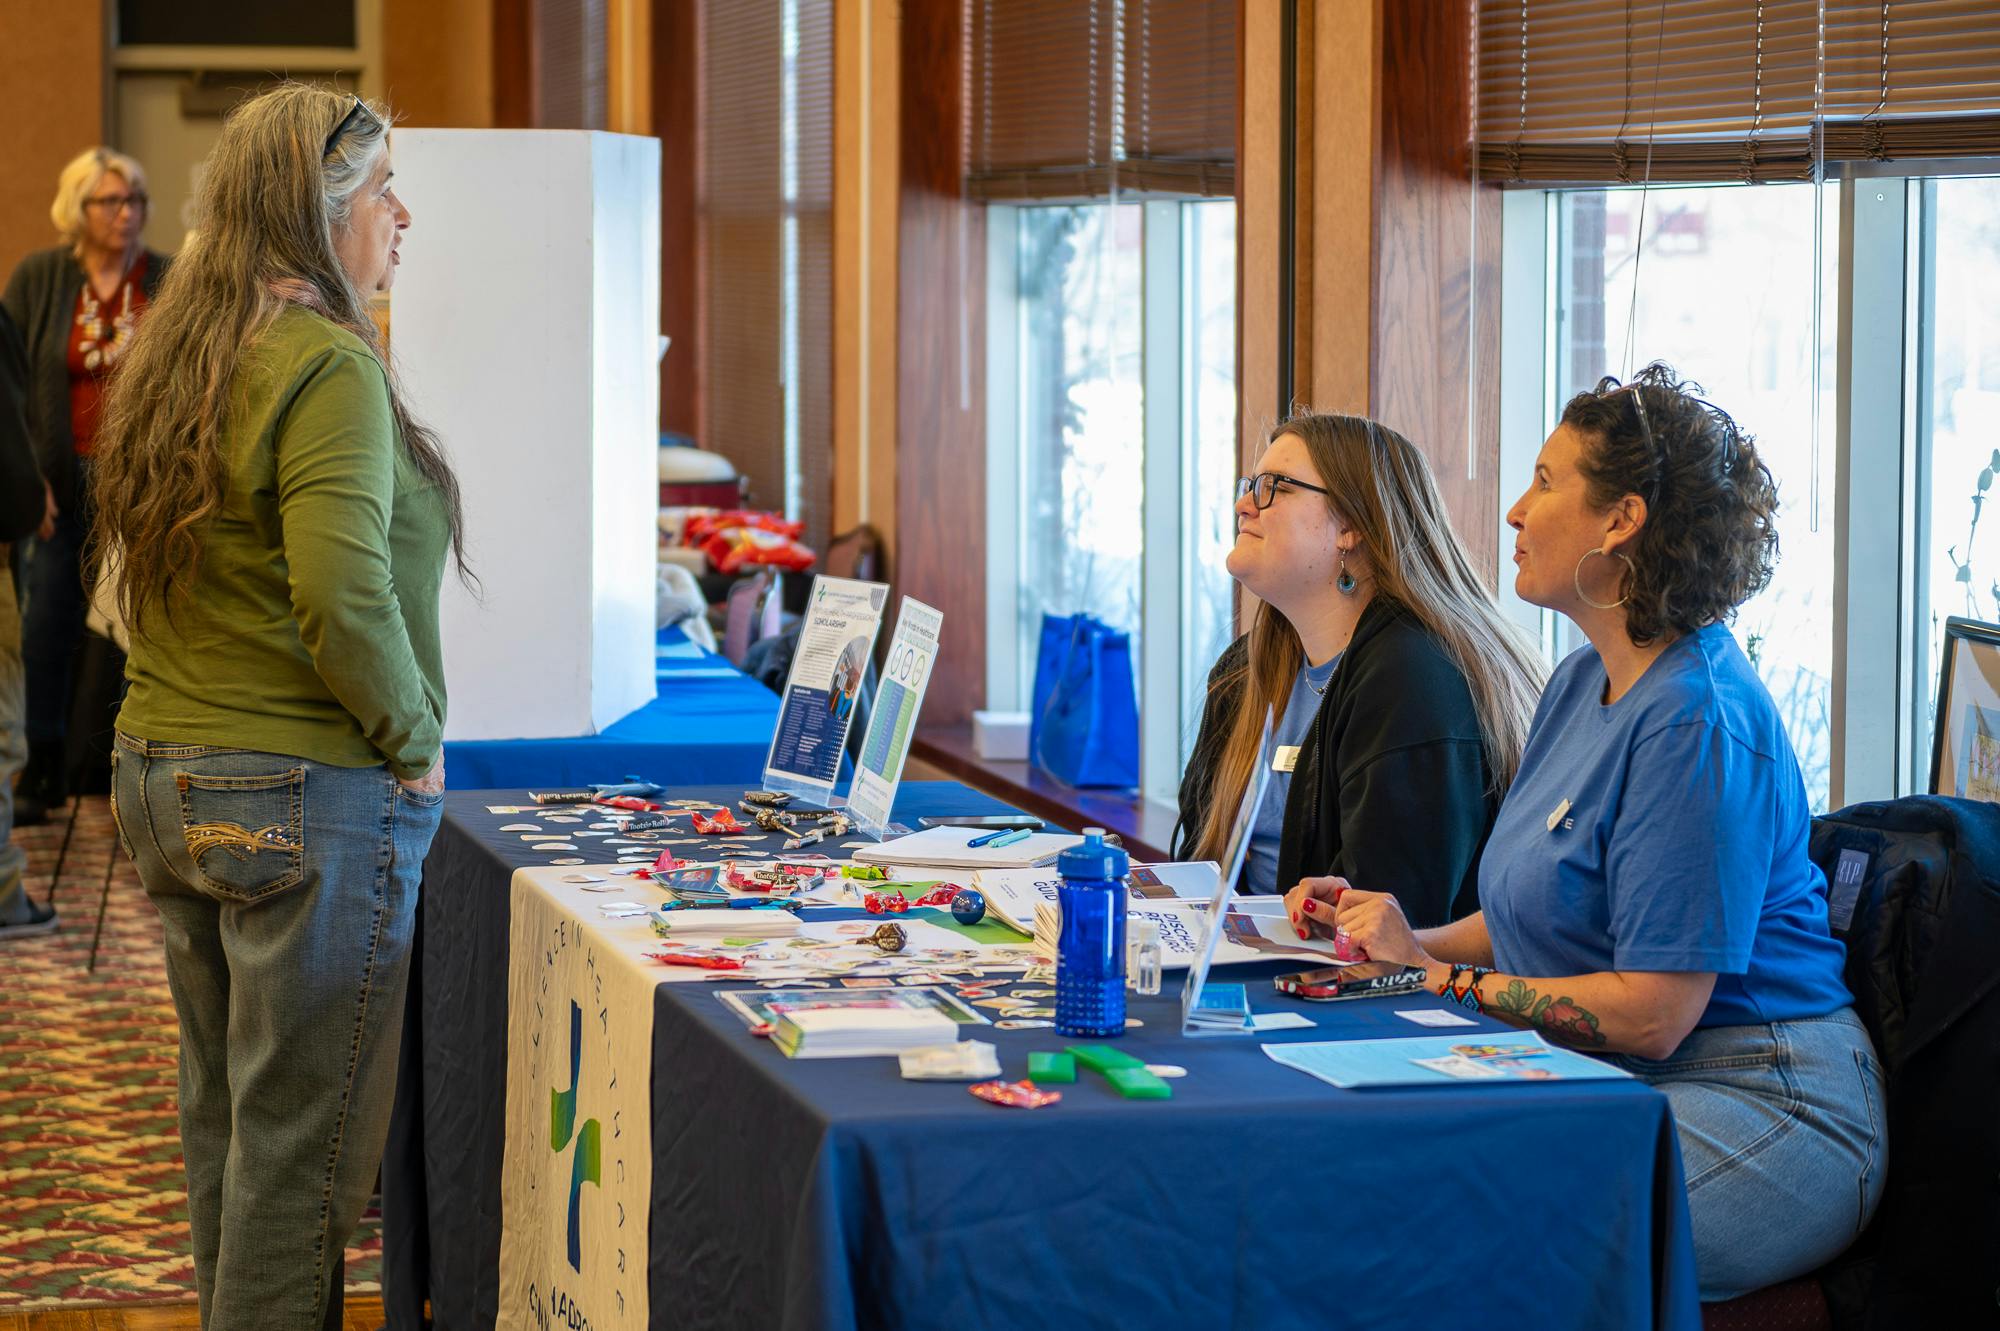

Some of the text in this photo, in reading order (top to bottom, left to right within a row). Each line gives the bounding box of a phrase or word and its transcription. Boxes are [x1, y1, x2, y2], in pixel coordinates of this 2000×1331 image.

[813, 617, 847, 629] SCHOLARSHIP
[628, 818, 666, 831] Tootsie Roll
[1033, 880, 1059, 901] GUID
